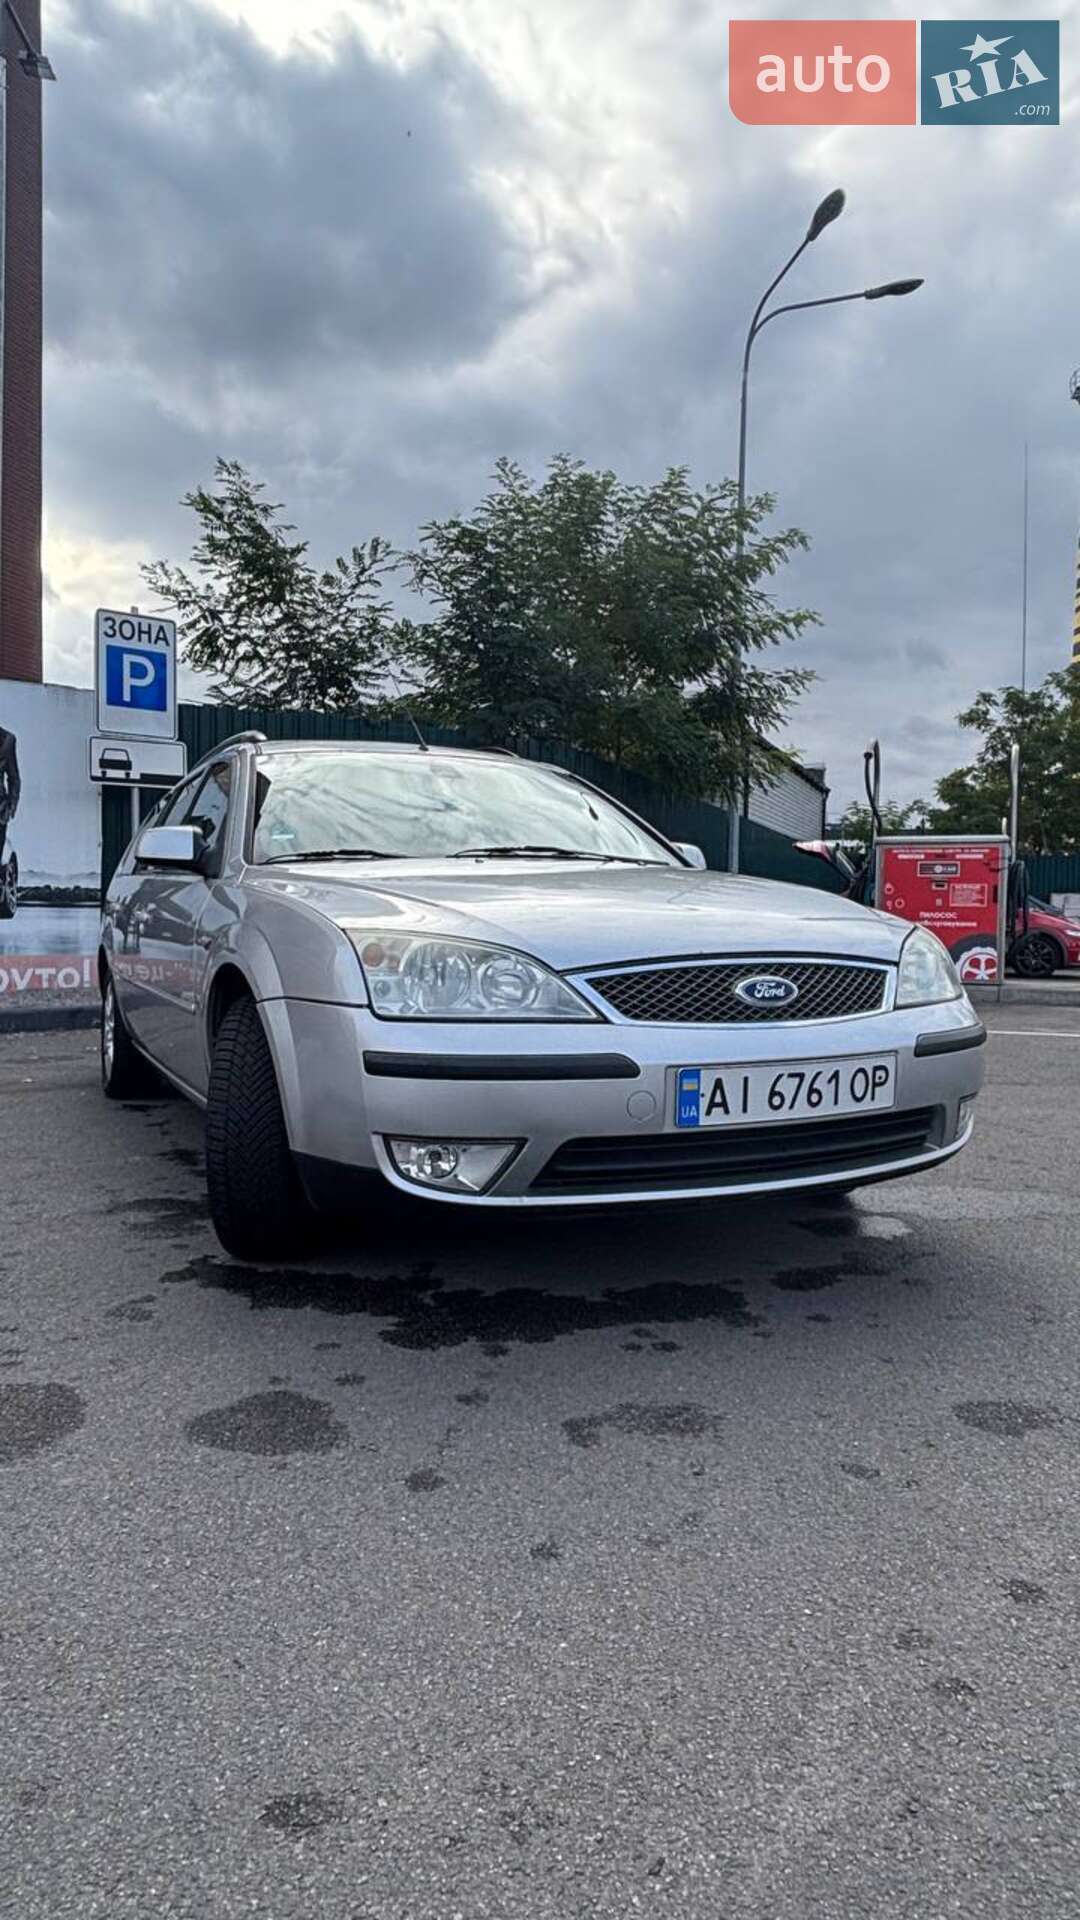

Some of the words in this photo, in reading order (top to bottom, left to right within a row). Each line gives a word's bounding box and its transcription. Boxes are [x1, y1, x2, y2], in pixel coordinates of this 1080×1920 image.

[103, 616, 170, 647] ЗОНА
[753, 982, 786, 998] Ford
[705, 1076, 749, 1116] AI
[768, 1069, 840, 1111] 6761
[850, 1064, 890, 1103] OP
[681, 1106, 698, 1118] UA
